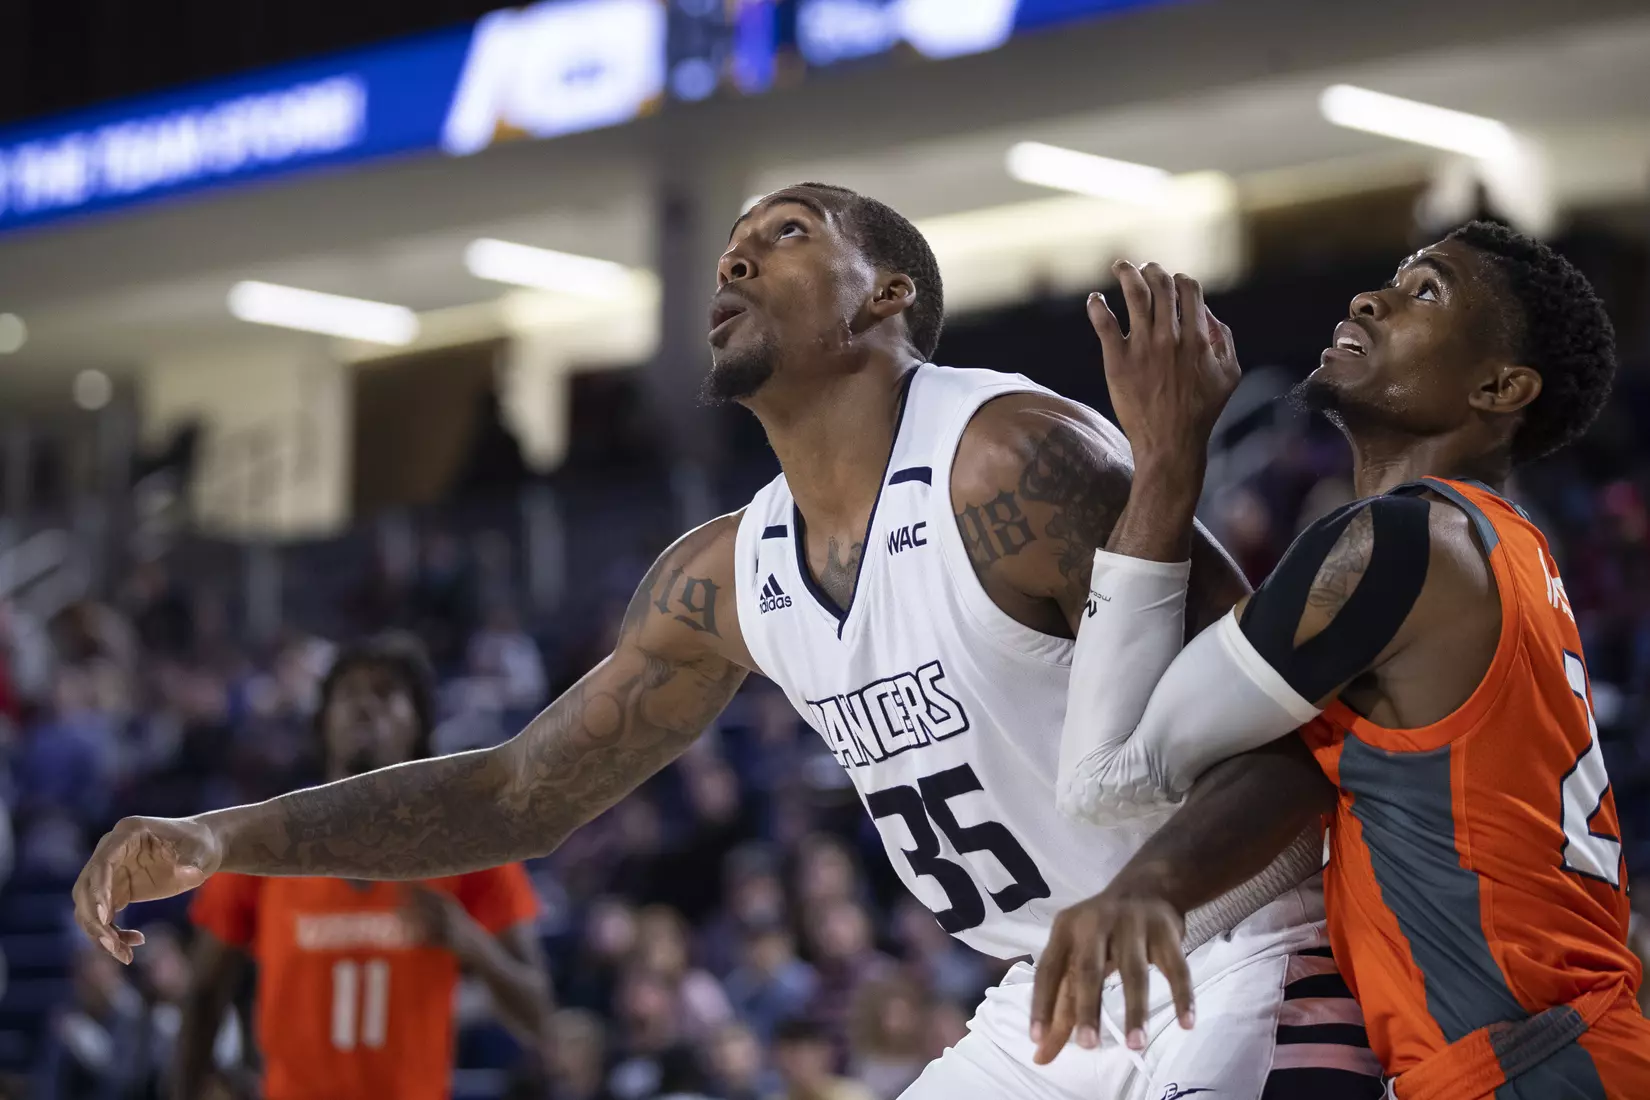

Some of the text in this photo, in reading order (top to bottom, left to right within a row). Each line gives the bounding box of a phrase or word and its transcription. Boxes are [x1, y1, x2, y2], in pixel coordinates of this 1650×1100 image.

[887, 521, 927, 556] WAC
[864, 762, 1052, 934] 35
[330, 958, 391, 1052] 11
